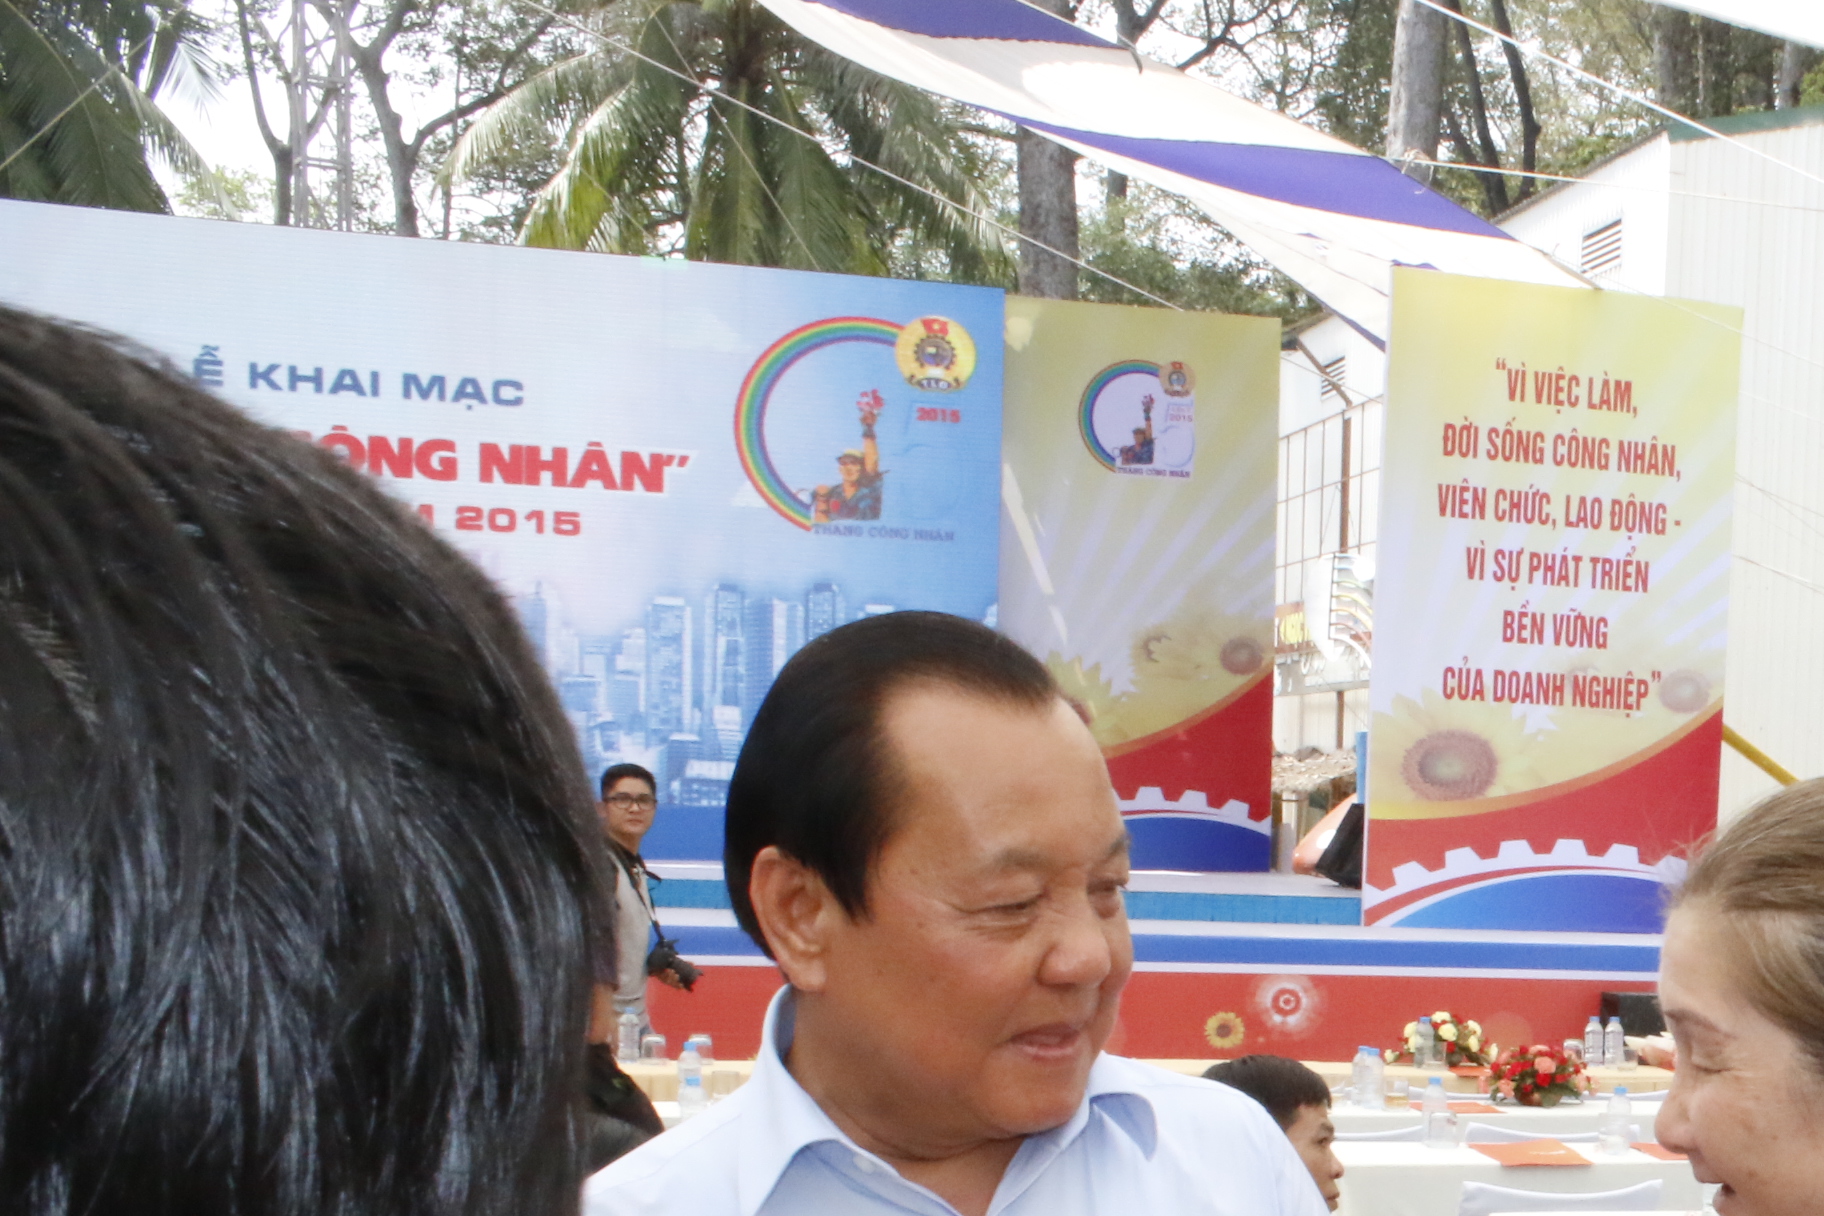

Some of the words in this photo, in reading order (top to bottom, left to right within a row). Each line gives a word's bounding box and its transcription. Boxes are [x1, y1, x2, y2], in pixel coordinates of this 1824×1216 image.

[192, 344, 224, 388] Ễ
[248, 361, 380, 398] KHAI
[402, 372, 525, 411] MẠC
[1534, 366, 1580, 415] VIỆC
[1587, 370, 1638, 419] LÀM,
[916, 406, 961, 424] 2015
[290, 424, 458, 482] ÔNG
[1442, 416, 1480, 459] ĐỜI
[1486, 416, 1546, 466] SỐNG
[1552, 427, 1611, 472] CÔNG
[1617, 435, 1682, 483] NHÂN,
[455, 505, 581, 537] 2015
[1437, 477, 1487, 521] VIÊN
[1494, 484, 1557, 531] CHỨC,
[1565, 494, 1603, 530] LAO
[1609, 492, 1668, 541] ĐỘNG
[1466, 540, 1486, 581] VÌ
[1492, 547, 1524, 592] SỰ
[1528, 546, 1583, 588] PHÁT
[1589, 545, 1650, 593] TRIỂN
[1552, 608, 1609, 650] VỮNG
[1442, 655, 1486, 702] CỦA
[1493, 669, 1566, 707] DOANH
